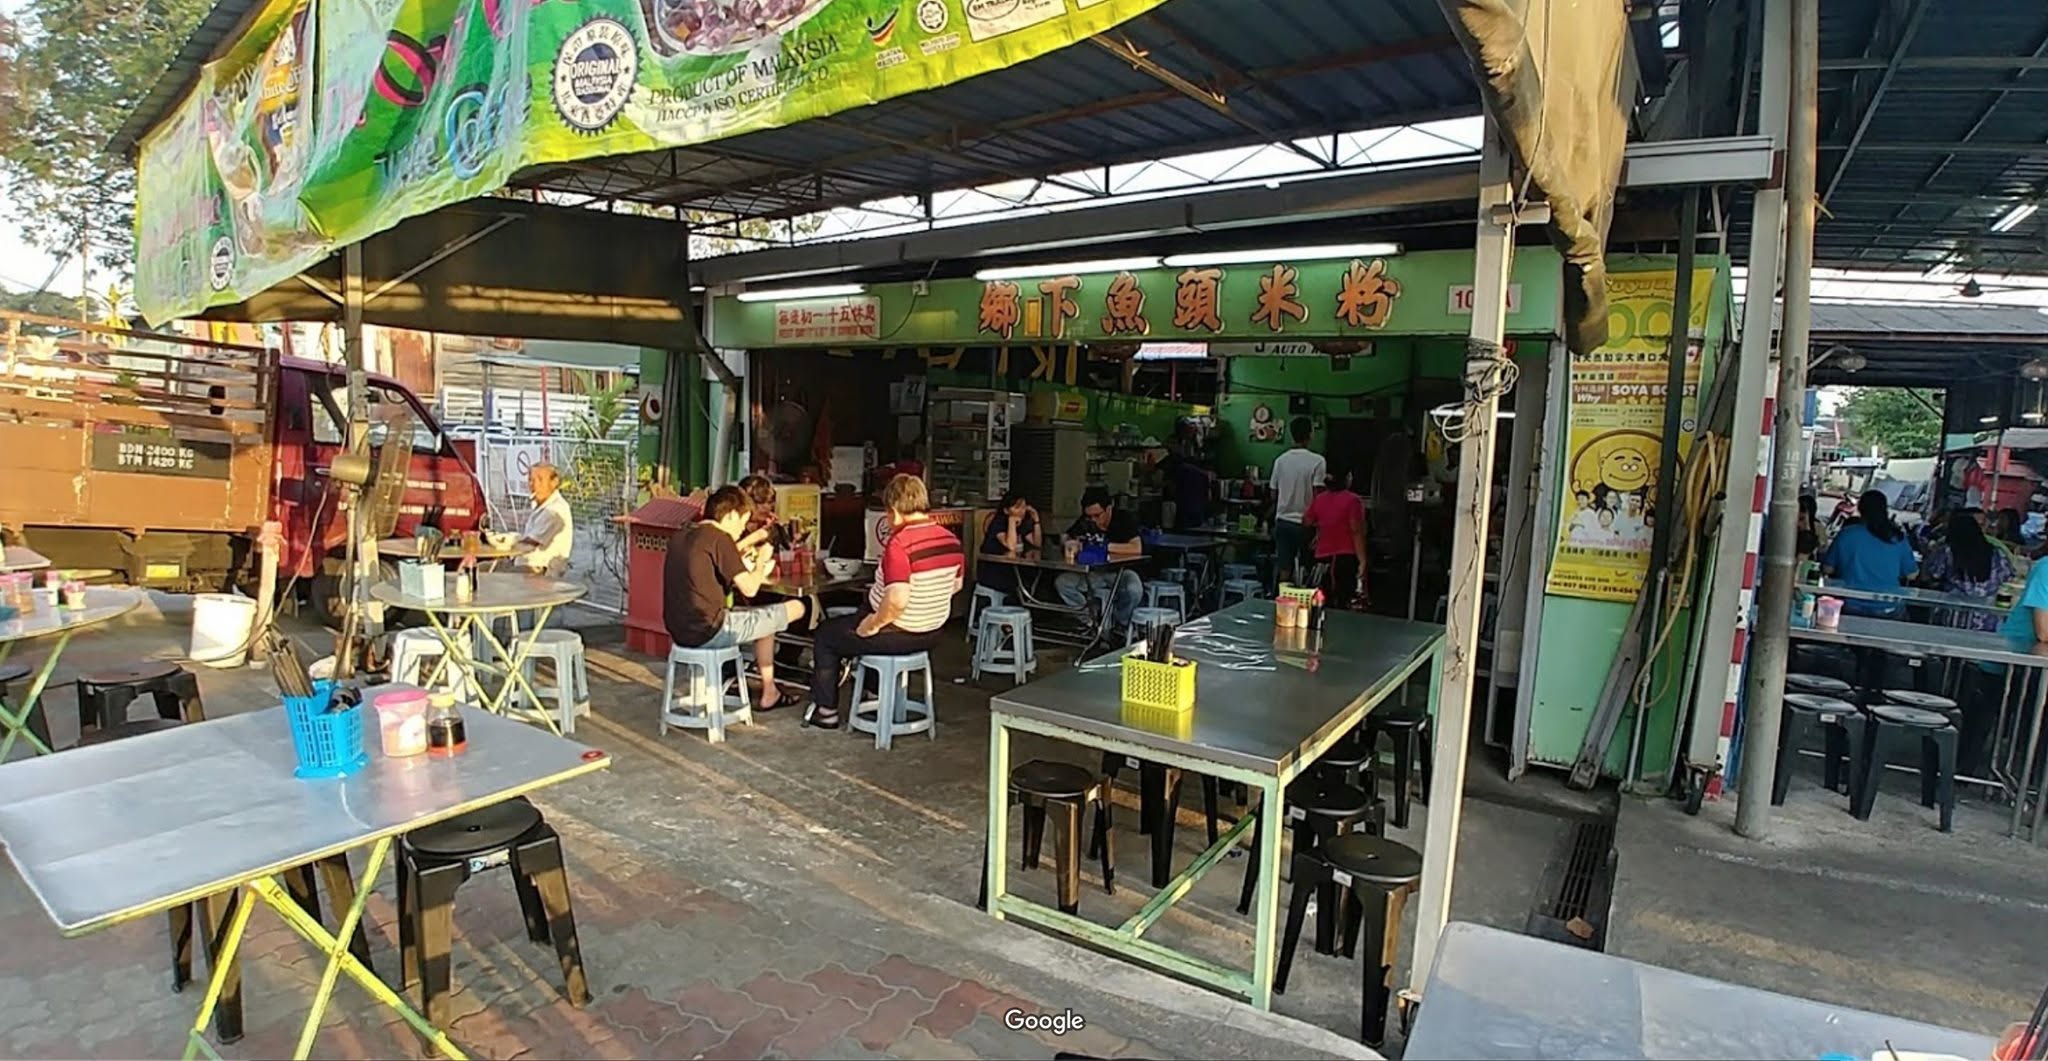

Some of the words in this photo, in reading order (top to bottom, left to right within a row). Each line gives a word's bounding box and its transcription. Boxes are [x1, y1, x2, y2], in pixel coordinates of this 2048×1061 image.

[570, 57, 622, 79] ORIGINAL
[649, 76, 725, 106] PRODUCT
[725, 64, 749, 88] OF
[753, 34, 840, 77] MALAYSIA
[656, 106, 702, 123] HACCP
[713, 95, 736, 112] ISO
[738, 78, 806, 106] CERTIFIED
[1271, 344, 1307, 355] AUTO
[1611, 384, 1648, 396] SOYA
[1576, 393, 1601, 404] Why
[178, 447, 194, 459] KG
[178, 458, 194, 470] KG
